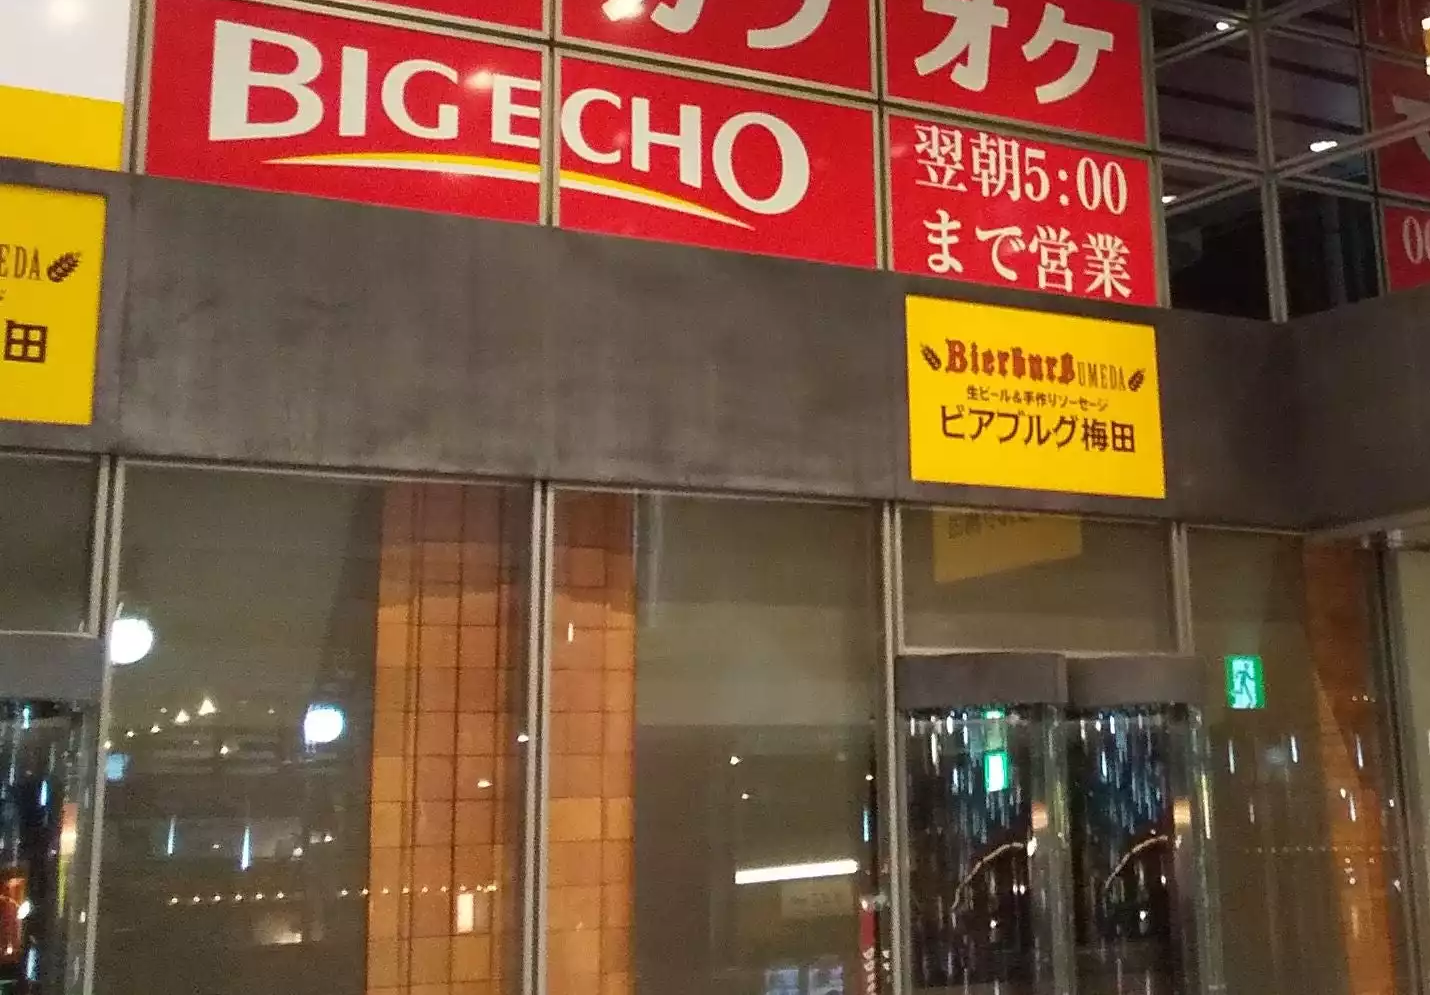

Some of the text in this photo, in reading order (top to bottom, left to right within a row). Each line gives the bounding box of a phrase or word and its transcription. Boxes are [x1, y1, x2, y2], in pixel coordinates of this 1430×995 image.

[207, 18, 461, 142] BIG
[922, 208, 1133, 299] まで営業
[3, 318, 48, 364] 田
[1076, 361, 1127, 393] UMEDA
[940, 404, 1136, 454] ビアブルグ梅田
